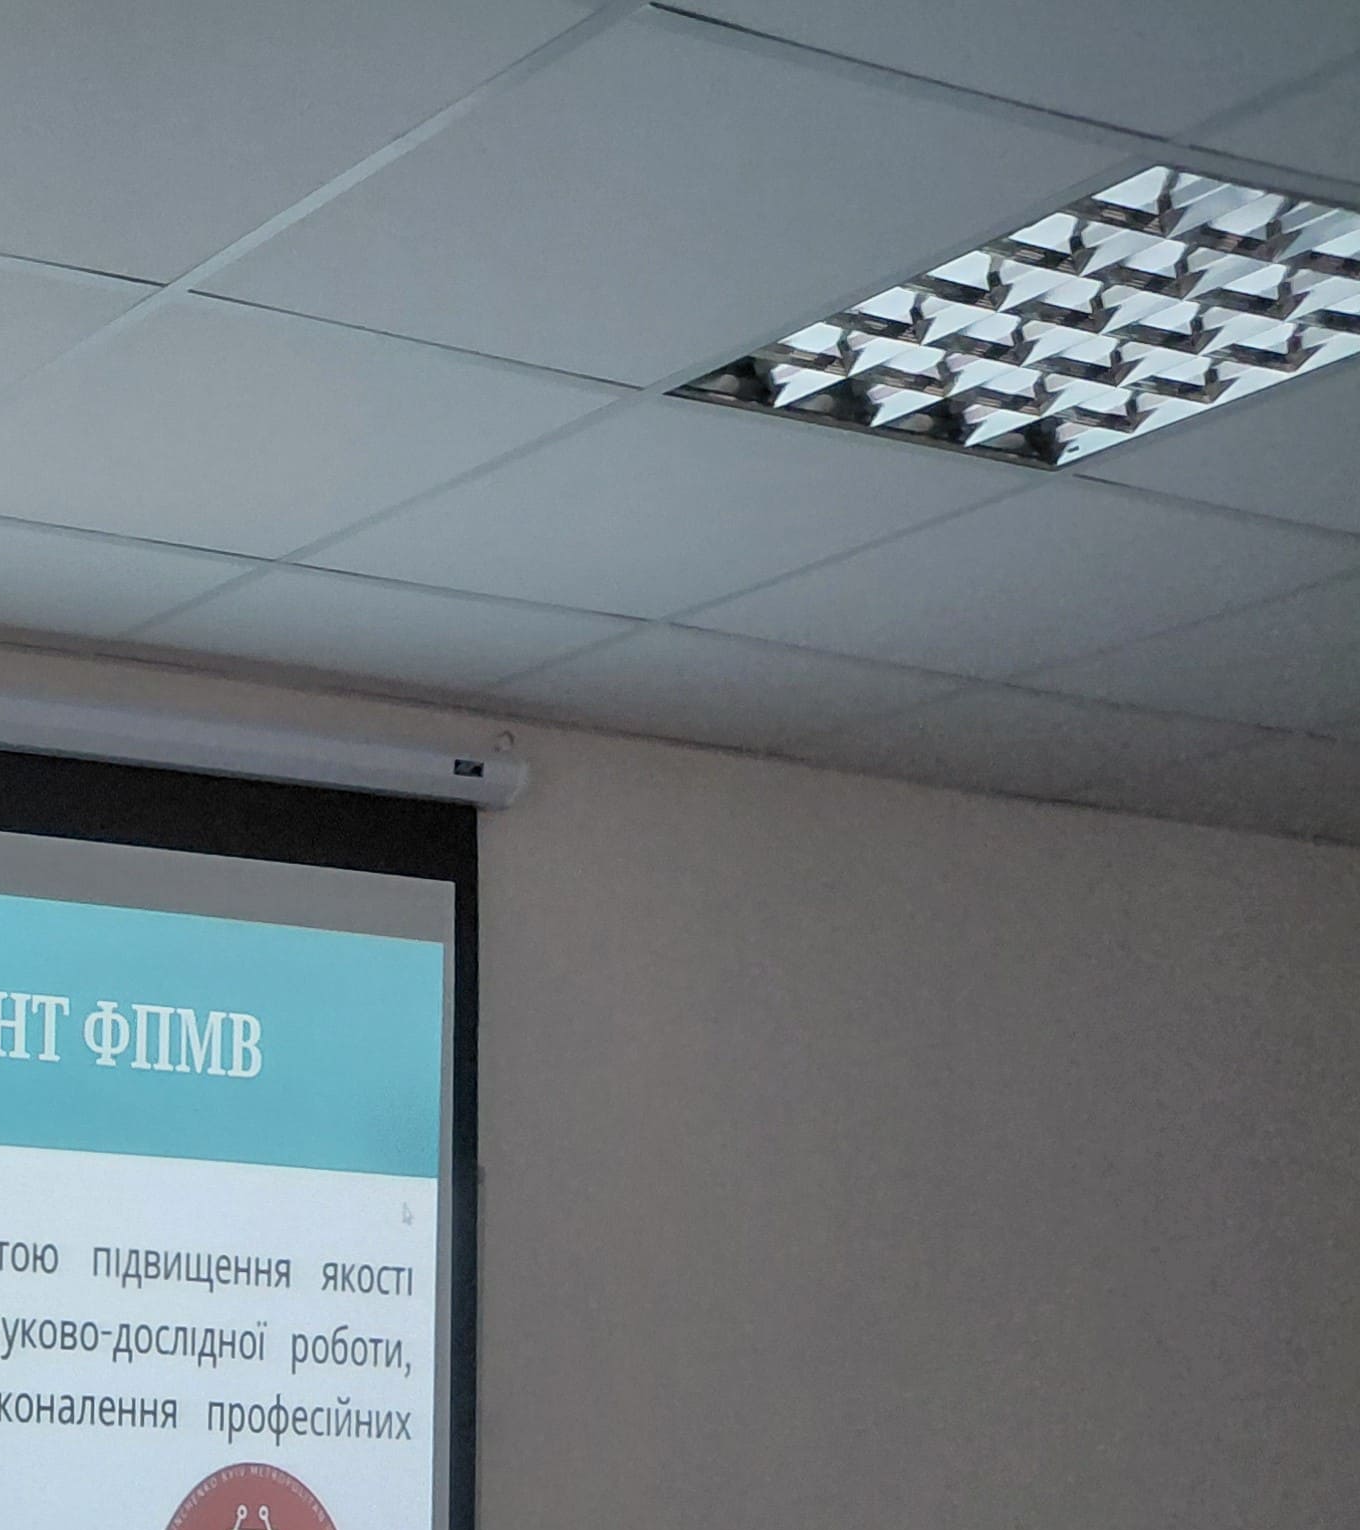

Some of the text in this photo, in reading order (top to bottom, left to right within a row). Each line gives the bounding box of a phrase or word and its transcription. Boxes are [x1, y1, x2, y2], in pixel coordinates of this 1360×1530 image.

[83, 1000, 262, 1078] ФПМВ
[92, 1246, 292, 1294] підвищення
[321, 1262, 413, 1297] якості
[291, 1324, 412, 1378] роботи,
[207, 1393, 412, 1448] професійних
